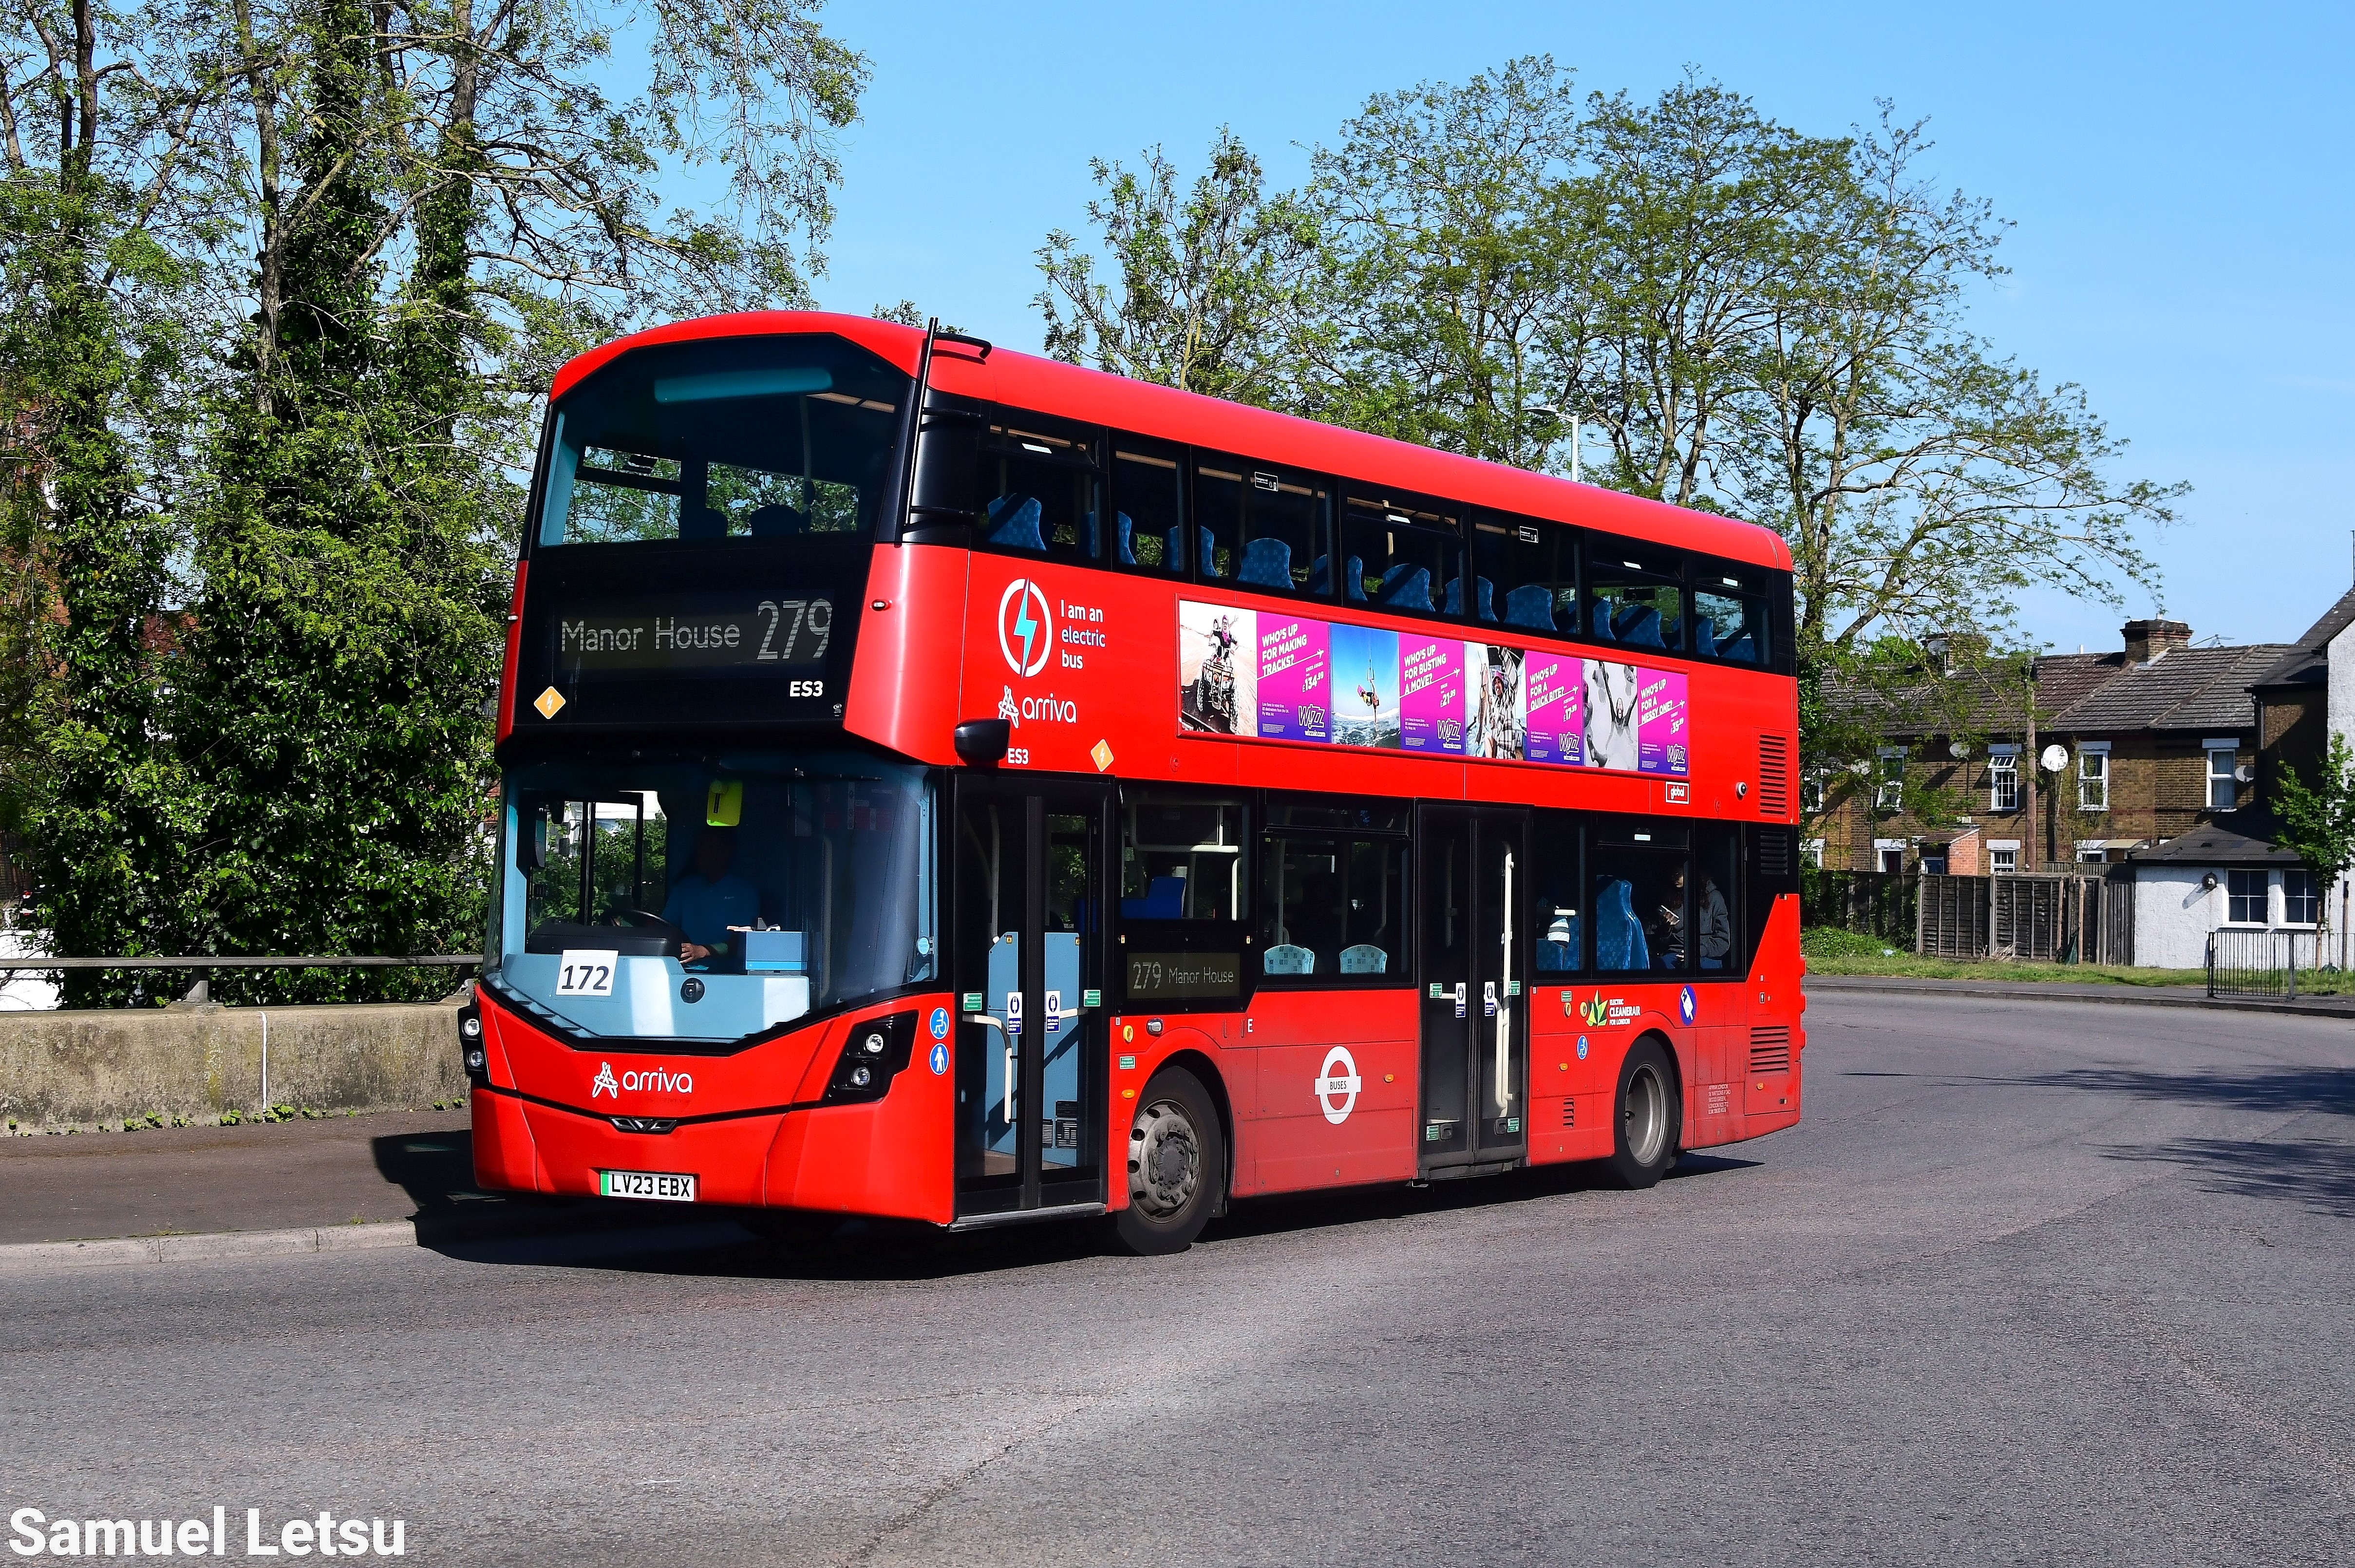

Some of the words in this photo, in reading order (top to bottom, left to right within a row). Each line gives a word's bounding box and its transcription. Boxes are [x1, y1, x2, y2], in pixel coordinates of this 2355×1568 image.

[1061, 599, 1065, 617] I
[1068, 605, 1086, 620] am
[1089, 607, 1104, 623] an
[562, 621, 643, 652] Manor
[655, 617, 740, 649] House
[757, 599, 832, 660] 279
[1061, 625, 1106, 647] electric
[1262, 628, 1286, 647] WHO'S
[1288, 623, 1298, 637] UP
[1062, 649, 1083, 669] bus
[1262, 646, 1277, 662] FOR
[1279, 634, 1307, 656] MAKING
[1404, 648, 1426, 667] WHO'S
[1427, 644, 1436, 657] UP
[1262, 654, 1294, 676] TRACKS?
[1404, 666, 1418, 681] FOR
[1419, 653, 1447, 675] BUSTING
[1529, 667, 1549, 685] WHO'S
[1549, 663, 1558, 676] UP
[790, 681, 823, 697] ES3
[1405, 683, 1410, 695] A
[1411, 673, 1433, 692] MOVE?
[1530, 683, 1542, 699] FOR
[1543, 681, 1548, 692] A
[1640, 682, 1658, 699] WHO'S
[1659, 678, 1666, 691] UP
[1022, 693, 1076, 723] arriva
[1530, 693, 1548, 711] QUICK
[1549, 686, 1564, 701] BITE?
[1641, 698, 1652, 712] FOR
[1653, 696, 1657, 706] A
[1641, 707, 1659, 724] MESSY
[1659, 699, 1673, 715] ONE?
[1008, 748, 1029, 765] ES3
[1671, 786, 1684, 799] global
[562, 965, 609, 990] 172
[1133, 962, 1162, 989] 279
[1169, 967, 1200, 983] Manor
[1204, 966, 1234, 983] House
[1247, 1019, 1253, 1033] E
[622, 1067, 693, 1093] arriva
[1330, 1081, 1347, 1090] BUSES
[611, 1174, 653, 1195] LV23
[659, 1177, 690, 1197] EBX
